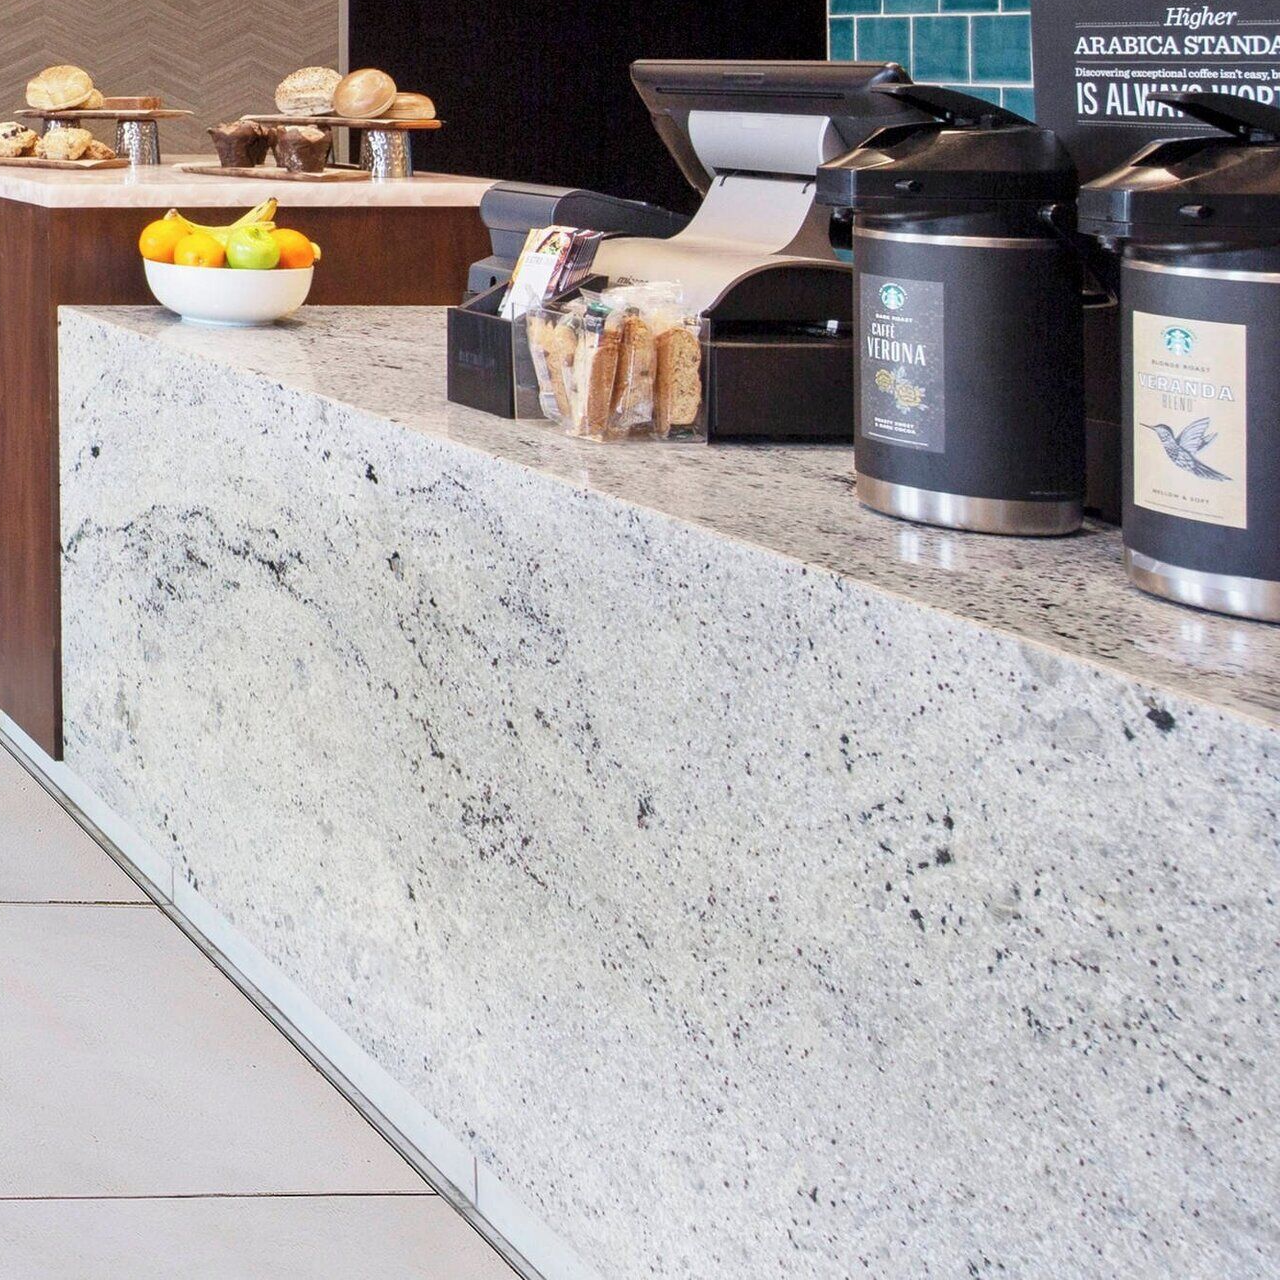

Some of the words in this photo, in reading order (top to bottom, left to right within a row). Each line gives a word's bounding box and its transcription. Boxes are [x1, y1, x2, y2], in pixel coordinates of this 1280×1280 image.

[1163, 6, 1238, 30] Higher
[1074, 36, 1181, 55] ARABICA
[1075, 68, 1130, 79] Discovering
[1131, 68, 1187, 79] exceptional
[1188, 69, 1219, 79] coffee
[1220, 69, 1243, 79] isn't
[1243, 71, 1270, 80] easy,
[1076, 82, 1098, 115] IS
[871, 322, 896, 339] CAFFÈ
[867, 336, 926, 366] VERONA
[1151, 359, 1180, 369] BLONDE
[1183, 364, 1210, 373] ROAST
[1138, 371, 1235, 402] VERANDA
[1161, 393, 1193, 413] BLEND
